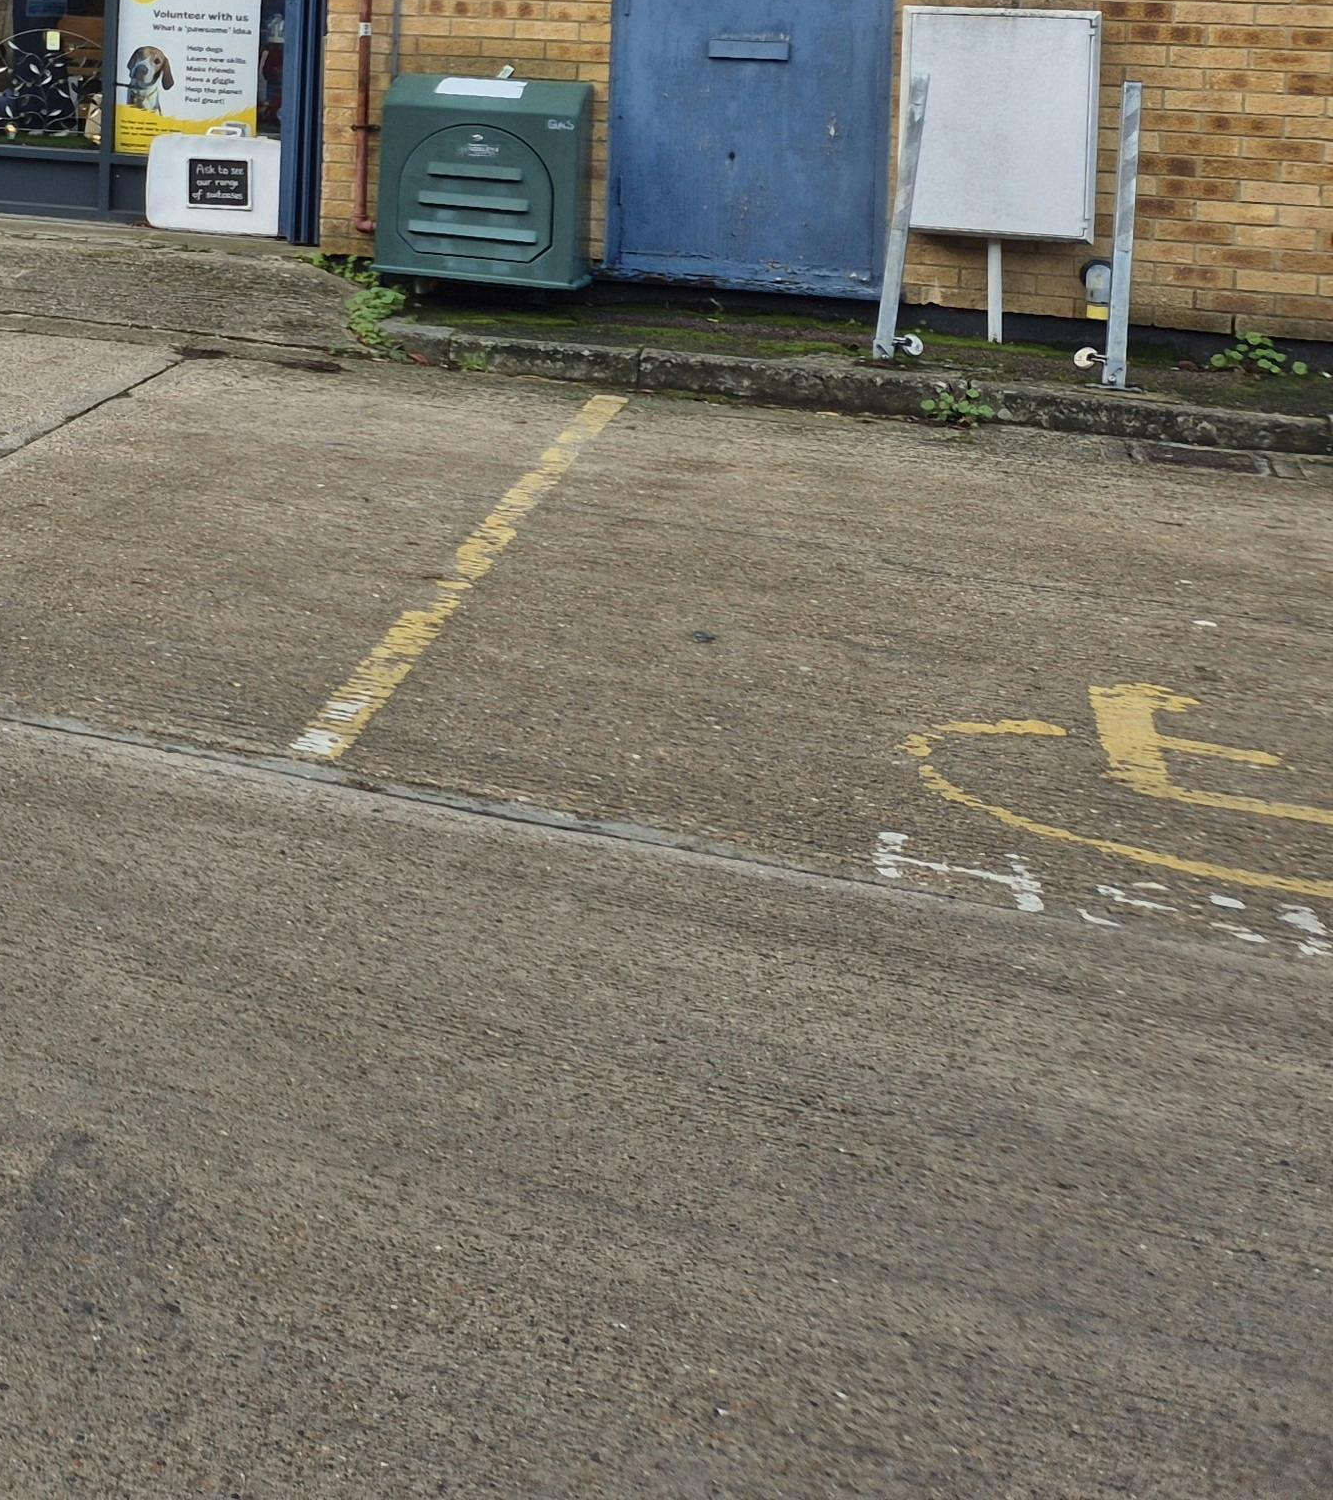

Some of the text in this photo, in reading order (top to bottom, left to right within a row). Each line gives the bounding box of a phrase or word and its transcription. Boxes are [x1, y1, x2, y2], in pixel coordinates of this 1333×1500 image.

[153, 9, 250, 22] Volunteer with us
[233, 27, 252, 35] idea
[196, 164, 216, 175] Ask
[217, 165, 229, 175] to
[214, 180, 239, 190] range
[192, 189, 203, 200] of
